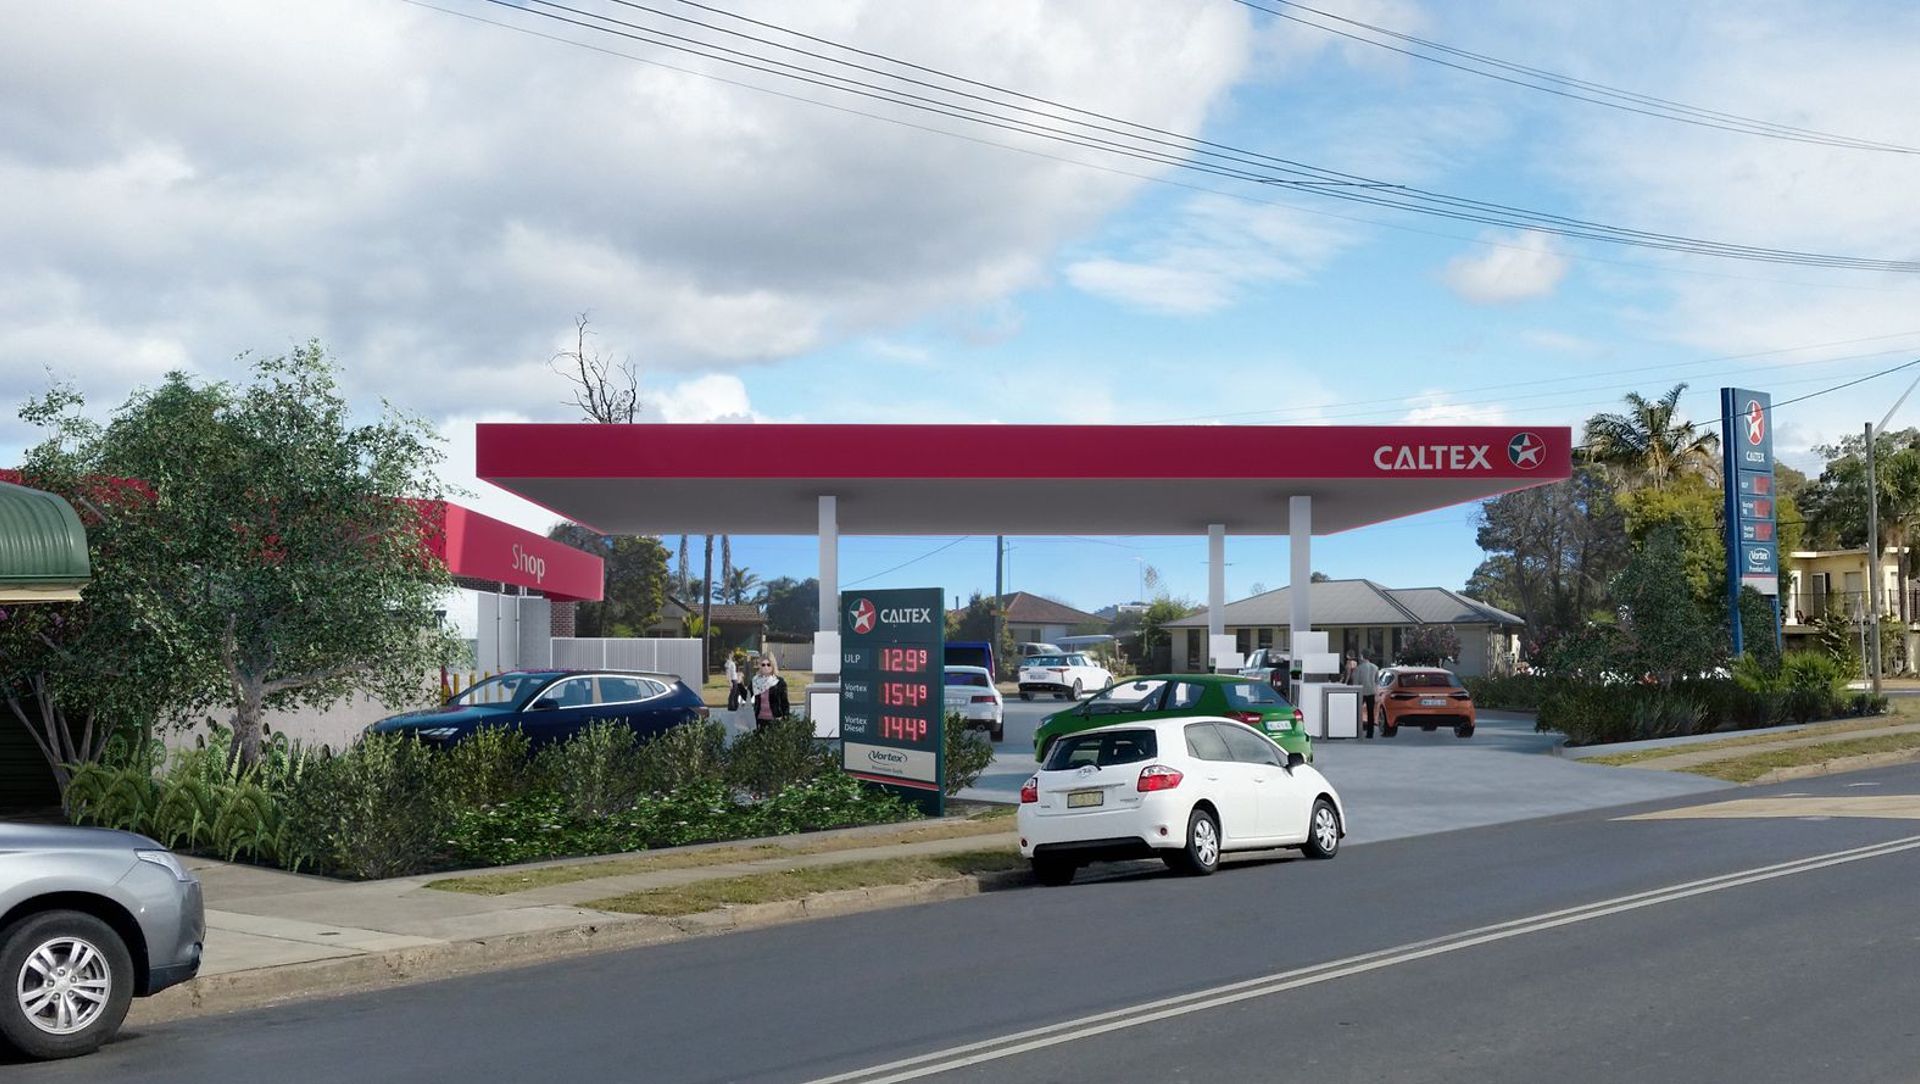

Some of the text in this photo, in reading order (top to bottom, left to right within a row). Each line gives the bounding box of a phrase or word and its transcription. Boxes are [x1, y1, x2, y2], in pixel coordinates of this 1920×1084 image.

[1374, 445, 1492, 470] CALTEX
[512, 543, 545, 584] Shop
[880, 608, 931, 624] CALTEX
[844, 654, 861, 664] ULP
[845, 683, 867, 693] Vortex
[845, 716, 867, 726] Vortex
[844, 724, 865, 733] Diesel
[871, 750, 903, 763] Vortex
